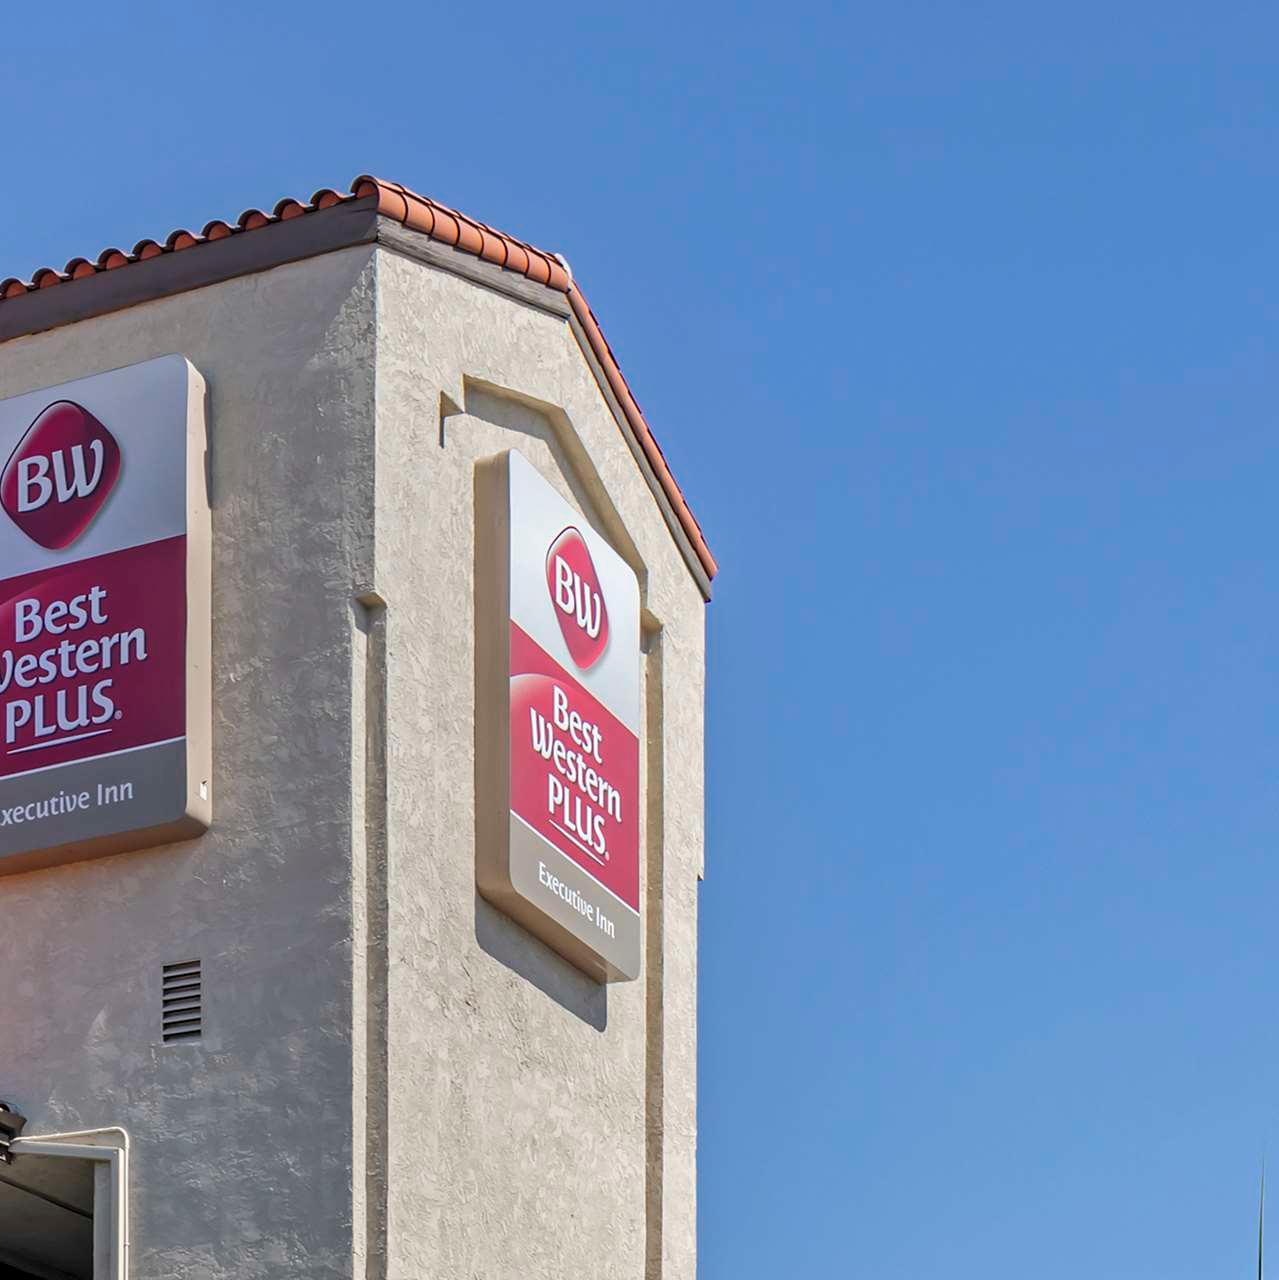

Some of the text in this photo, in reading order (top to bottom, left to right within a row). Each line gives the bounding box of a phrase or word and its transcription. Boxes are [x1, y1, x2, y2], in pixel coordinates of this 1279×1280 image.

[17, 439, 104, 513] BW
[15, 585, 108, 643] Best
[555, 554, 601, 639] BW
[553, 685, 602, 764] Best
[97, 783, 133, 806] Inn
[530, 707, 622, 823] Western
[538, 861, 615, 939] Executive Inn
